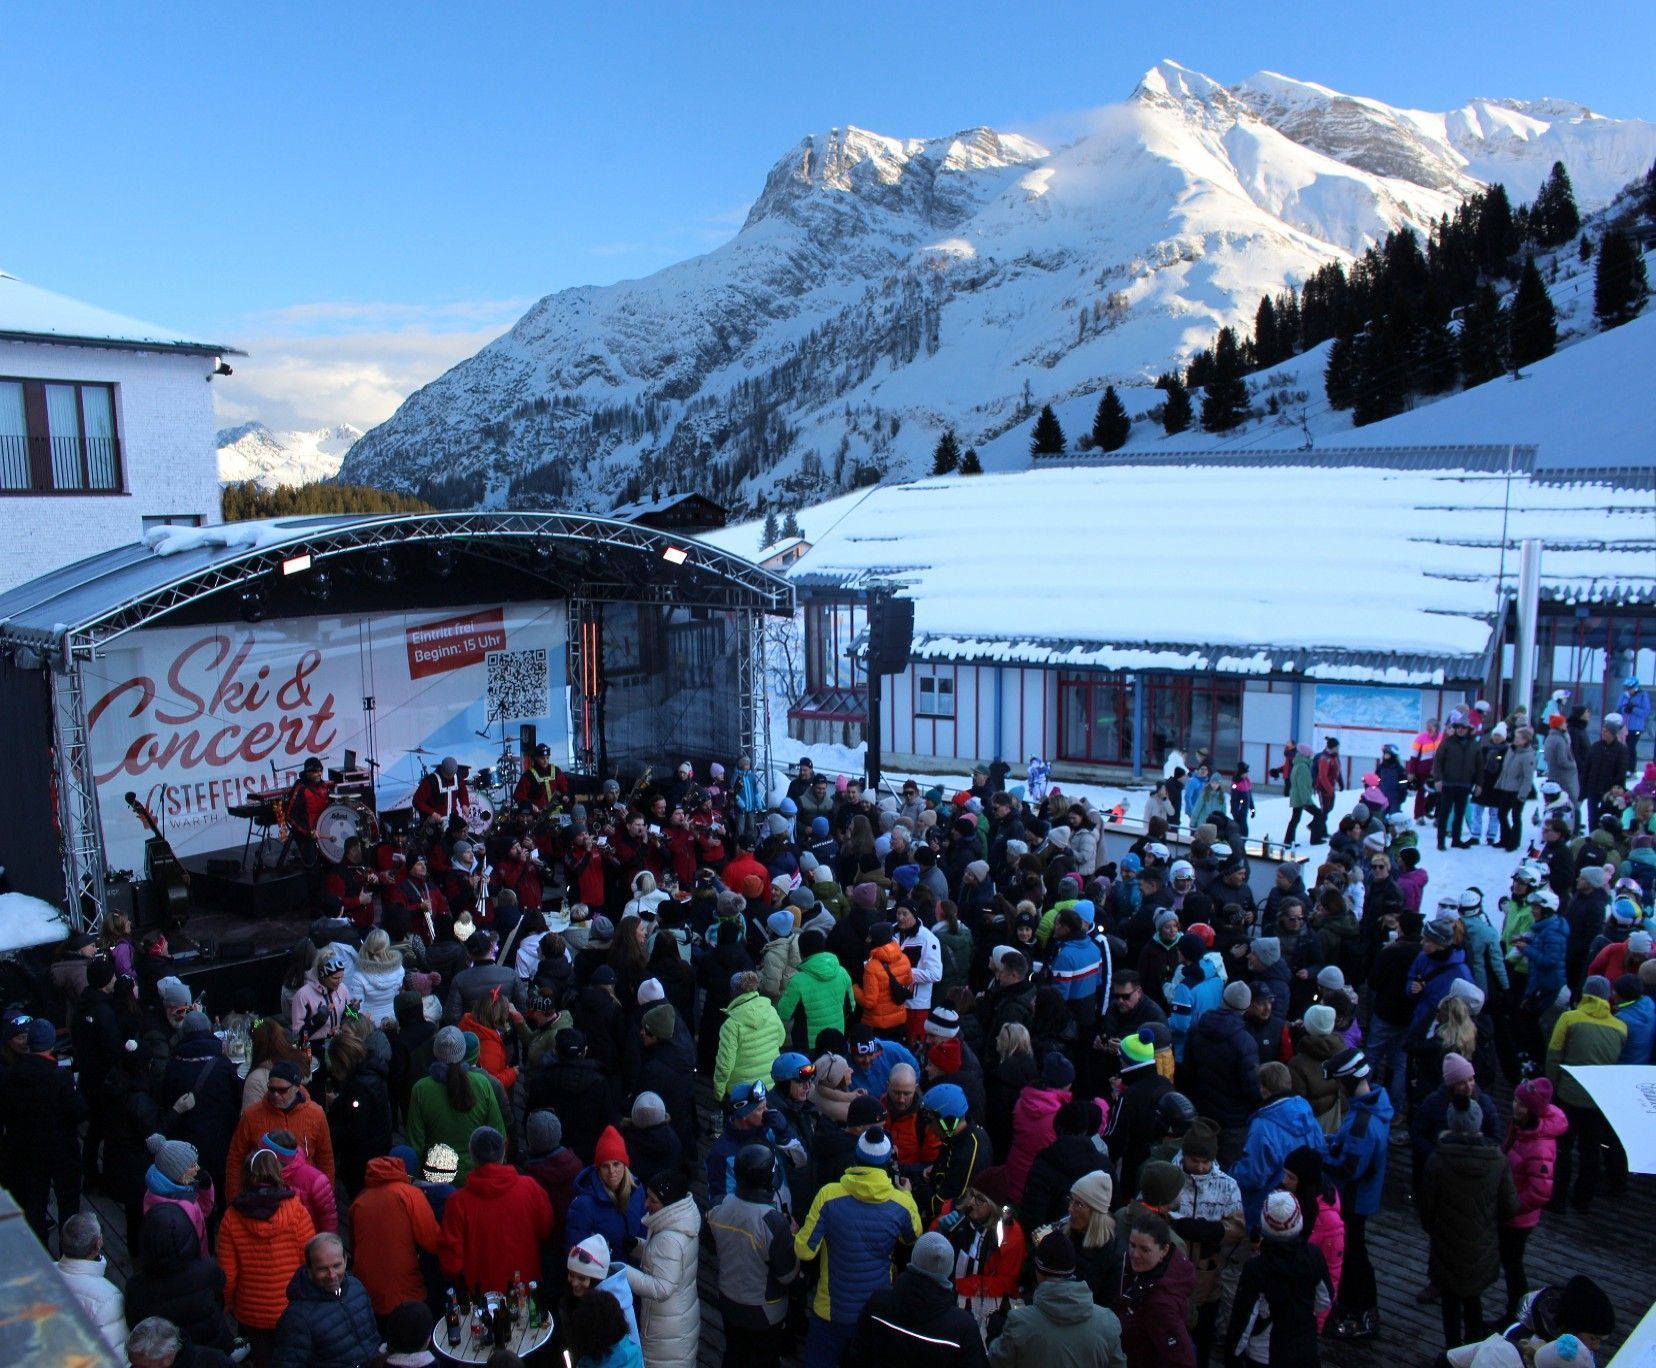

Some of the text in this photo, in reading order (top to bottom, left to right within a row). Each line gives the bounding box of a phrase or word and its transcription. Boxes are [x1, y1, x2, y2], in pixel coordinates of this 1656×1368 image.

[412, 621, 475, 645] Eintritt frei
[415, 635, 501, 662] Beginn: 15 Uhr
[155, 631, 322, 725] Ski &
[72, 676, 337, 785] Concert
[170, 814, 219, 829] WARTH
